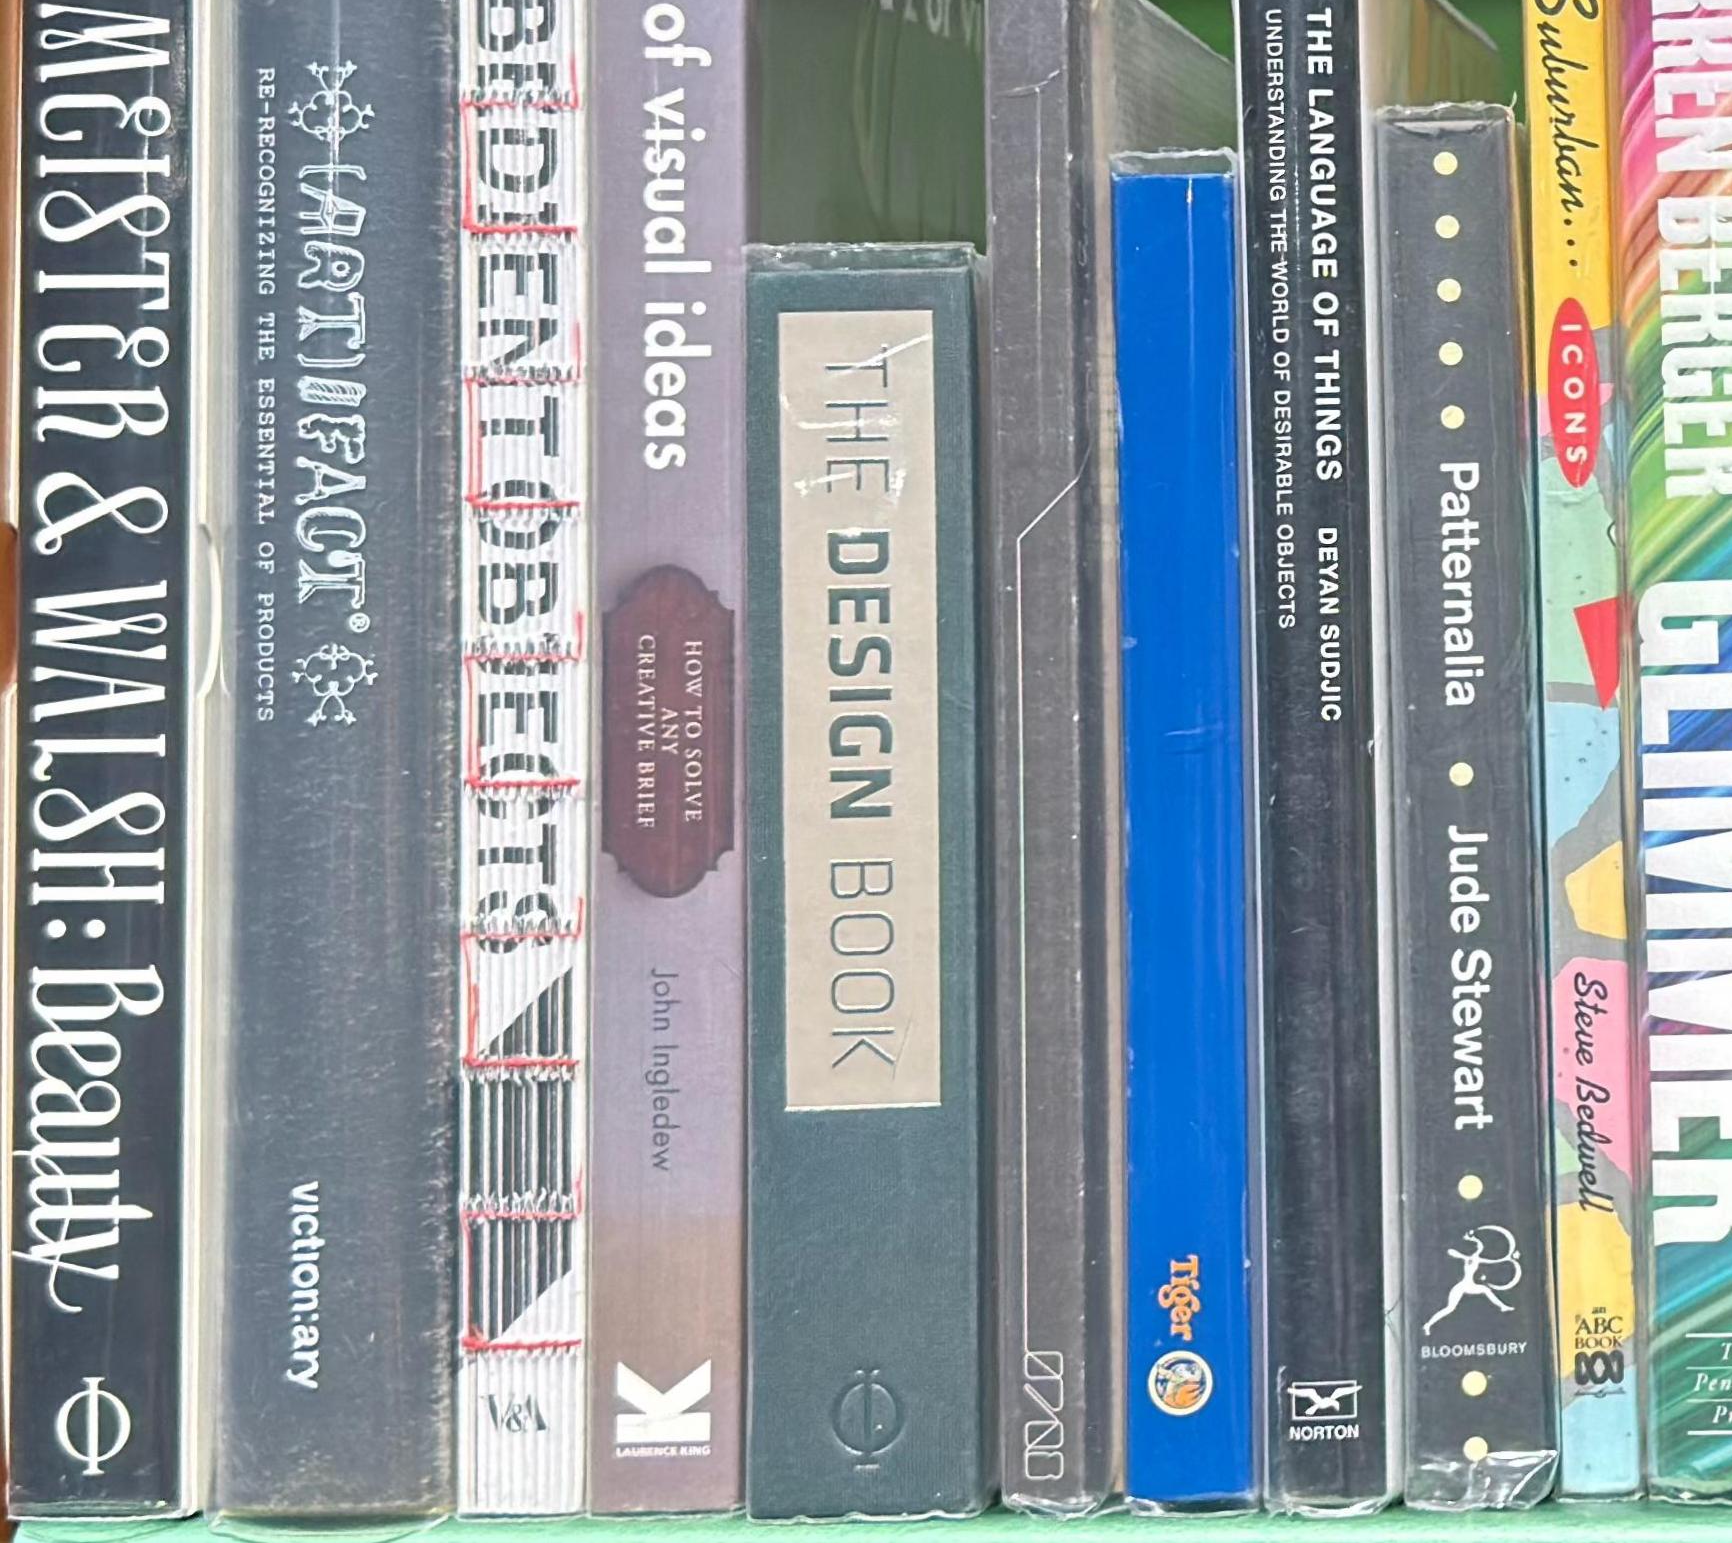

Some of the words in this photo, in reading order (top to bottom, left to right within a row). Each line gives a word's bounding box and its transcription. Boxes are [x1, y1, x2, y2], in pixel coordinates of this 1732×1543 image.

[641, 9, 710, 68] of
[1307, 8, 1332, 75] THE
[1265, 9, 1287, 201] UNDERSTANDING
[258, 67, 275, 294] RE-RECOGNIZING
[643, 87, 710, 273] visual
[1308, 88, 1338, 278] LANGUAGE
[1269, 210, 1288, 254] THE
[258, 312, 275, 361] THE
[1270, 259, 1290, 344] WORLD
[1312, 292, 1340, 337] OF
[641, 301, 710, 470] ideas
[1272, 351, 1291, 382] OF
[1561, 323, 1586, 466] ICONS
[258, 377, 275, 525] ESSENTIAL
[825, 344, 890, 492] THE
[1274, 390, 1293, 517] DESIRABLE
[1314, 350, 1342, 482] THINGS
[35, 472, 169, 555] &
[258, 541, 275, 574] OF
[1276, 523, 1296, 629] OBJECTS
[1317, 527, 1339, 615] DEYAN
[1439, 462, 1484, 706] Patternalia
[258, 592, 275, 722] PRODUCTS
[639, 635, 655, 752] CREATIVE
[685, 641, 703, 698] HOW
[828, 529, 893, 819] DESIGN
[1319, 625, 1342, 722] SUDJIC
[31, 579, 168, 939] WALSH:
[661, 708, 678, 754] ANY
[685, 709, 703, 739] TO
[639, 762, 655, 829] BRIEF
[685, 746, 703, 823] SOLVE
[1447, 823, 1489, 934] Jude
[652, 967, 678, 1032] John
[829, 859, 898, 1070] BOOK
[1450, 948, 1494, 1131] Stewart
[1572, 971, 1609, 1066] Steve
[12, 963, 166, 1314] Beauty
[645, 1041, 678, 1171] Ingledew
[1574, 1076, 1612, 1213] Bedwell
[1158, 1254, 1198, 1341] Tiger
[1575, 1335, 1623, 1349] BOOK
[1576, 1315, 1622, 1334] ABC
[1421, 1342, 1527, 1358] BLOOMSBURY
[616, 1447, 677, 1457] LAURENCE
[680, 1445, 711, 1456] KING
[1289, 1424, 1359, 1441] NORTON
